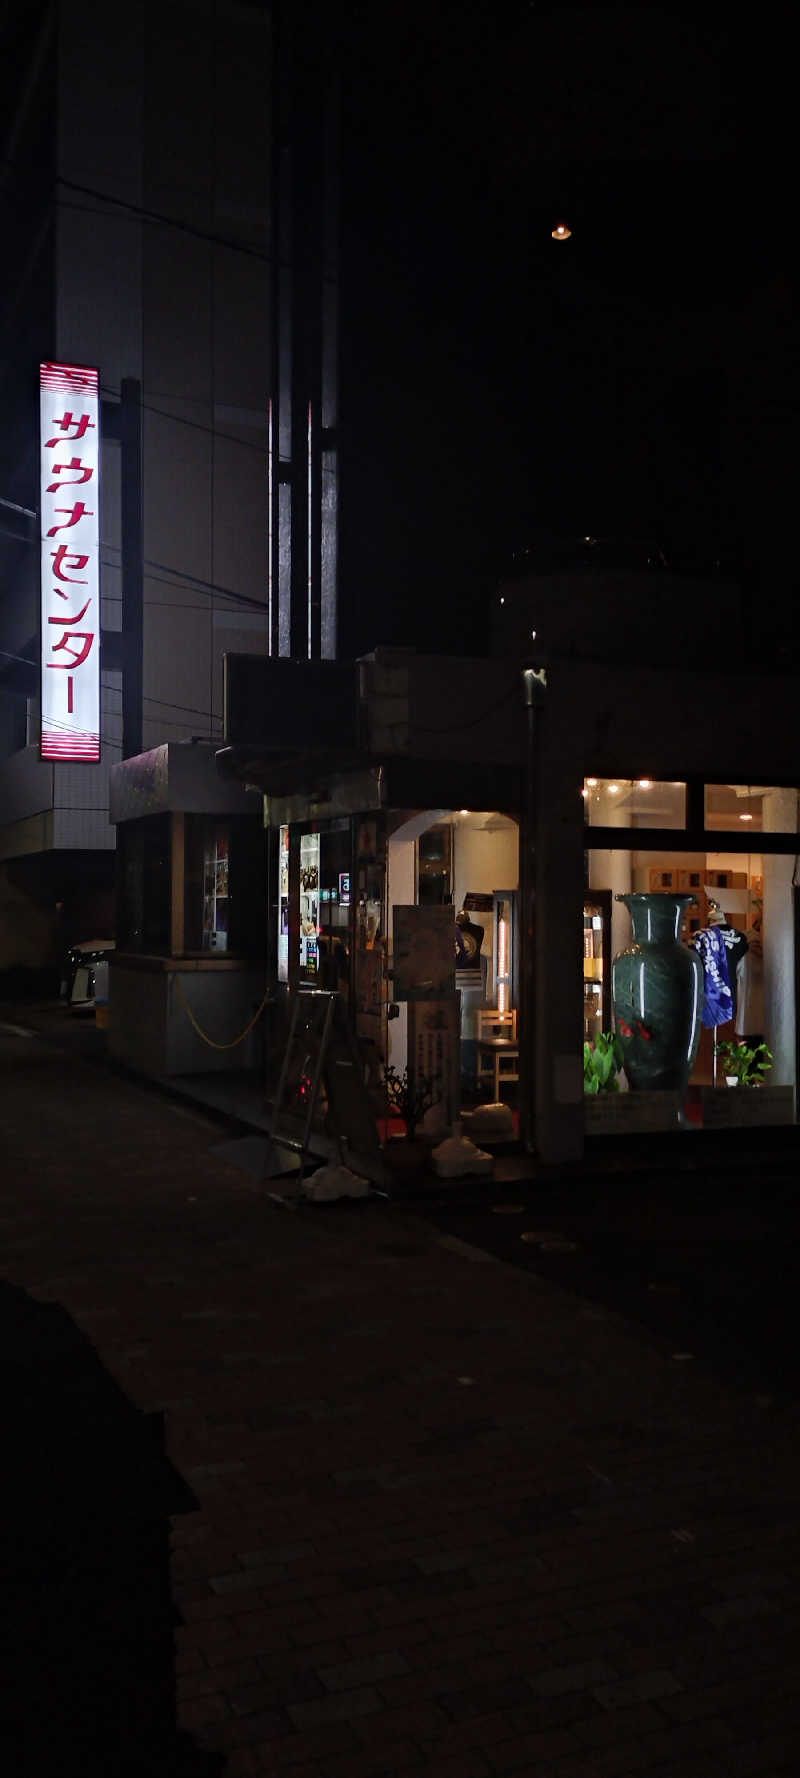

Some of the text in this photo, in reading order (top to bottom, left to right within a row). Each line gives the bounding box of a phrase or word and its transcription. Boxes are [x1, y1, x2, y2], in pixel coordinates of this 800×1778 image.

[45, 411, 95, 713] サウナセンター
